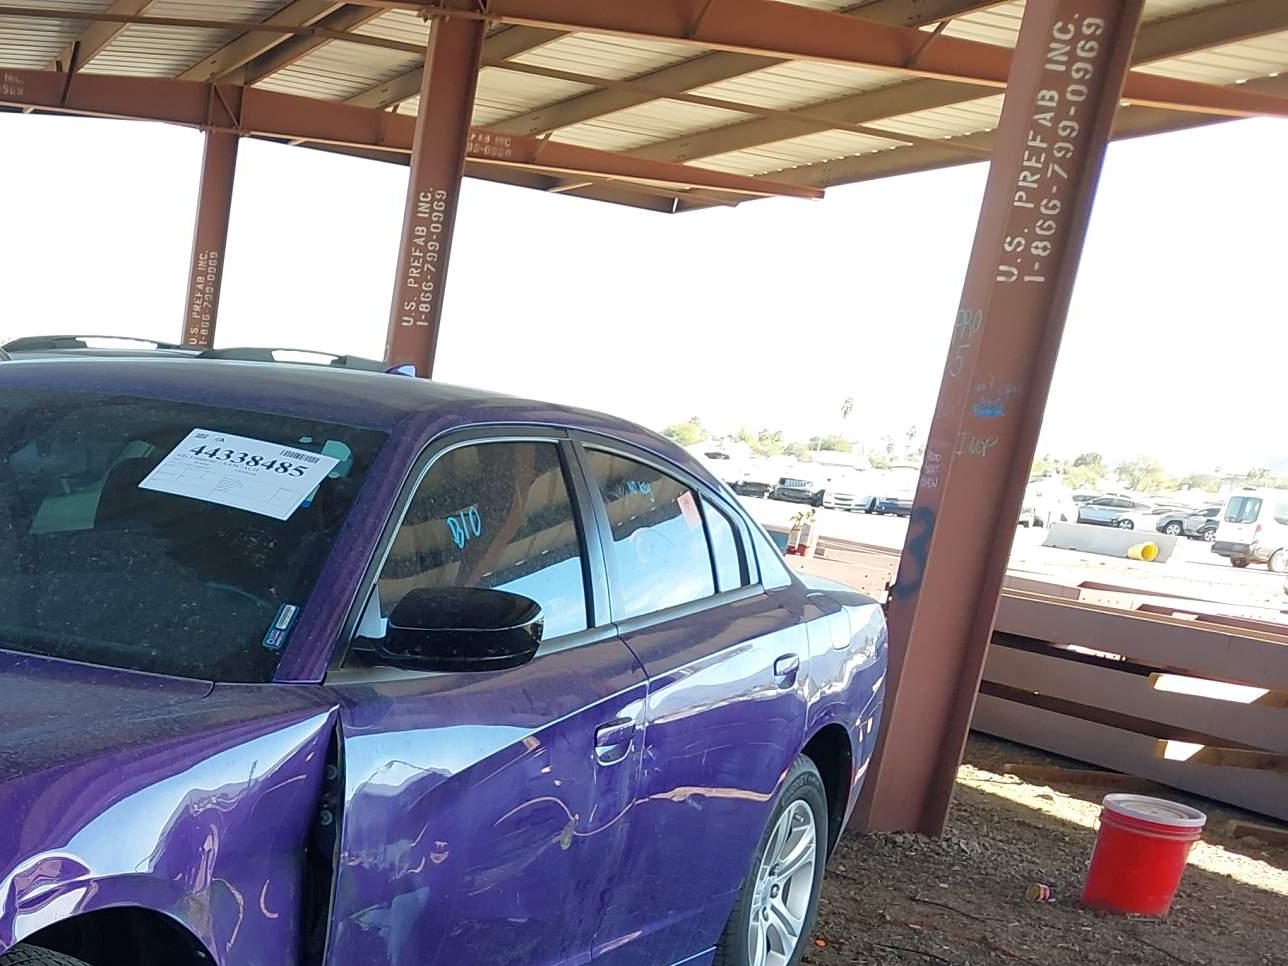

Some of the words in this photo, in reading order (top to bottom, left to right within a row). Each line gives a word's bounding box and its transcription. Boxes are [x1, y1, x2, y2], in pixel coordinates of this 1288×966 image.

[996, 227, 1029, 283] U.S.
[1013, 89, 1059, 208] PREFAB
[1045, 13, 1080, 71] INC.
[1024, 16, 1104, 283] 1-866-799-0969
[417, 188, 433, 217] INC.
[408, 225, 427, 287] PREFAB
[192, 275, 206, 318] PREFAB
[401, 296, 417, 326] U.S.
[190, 444, 309, 479] 44338485
